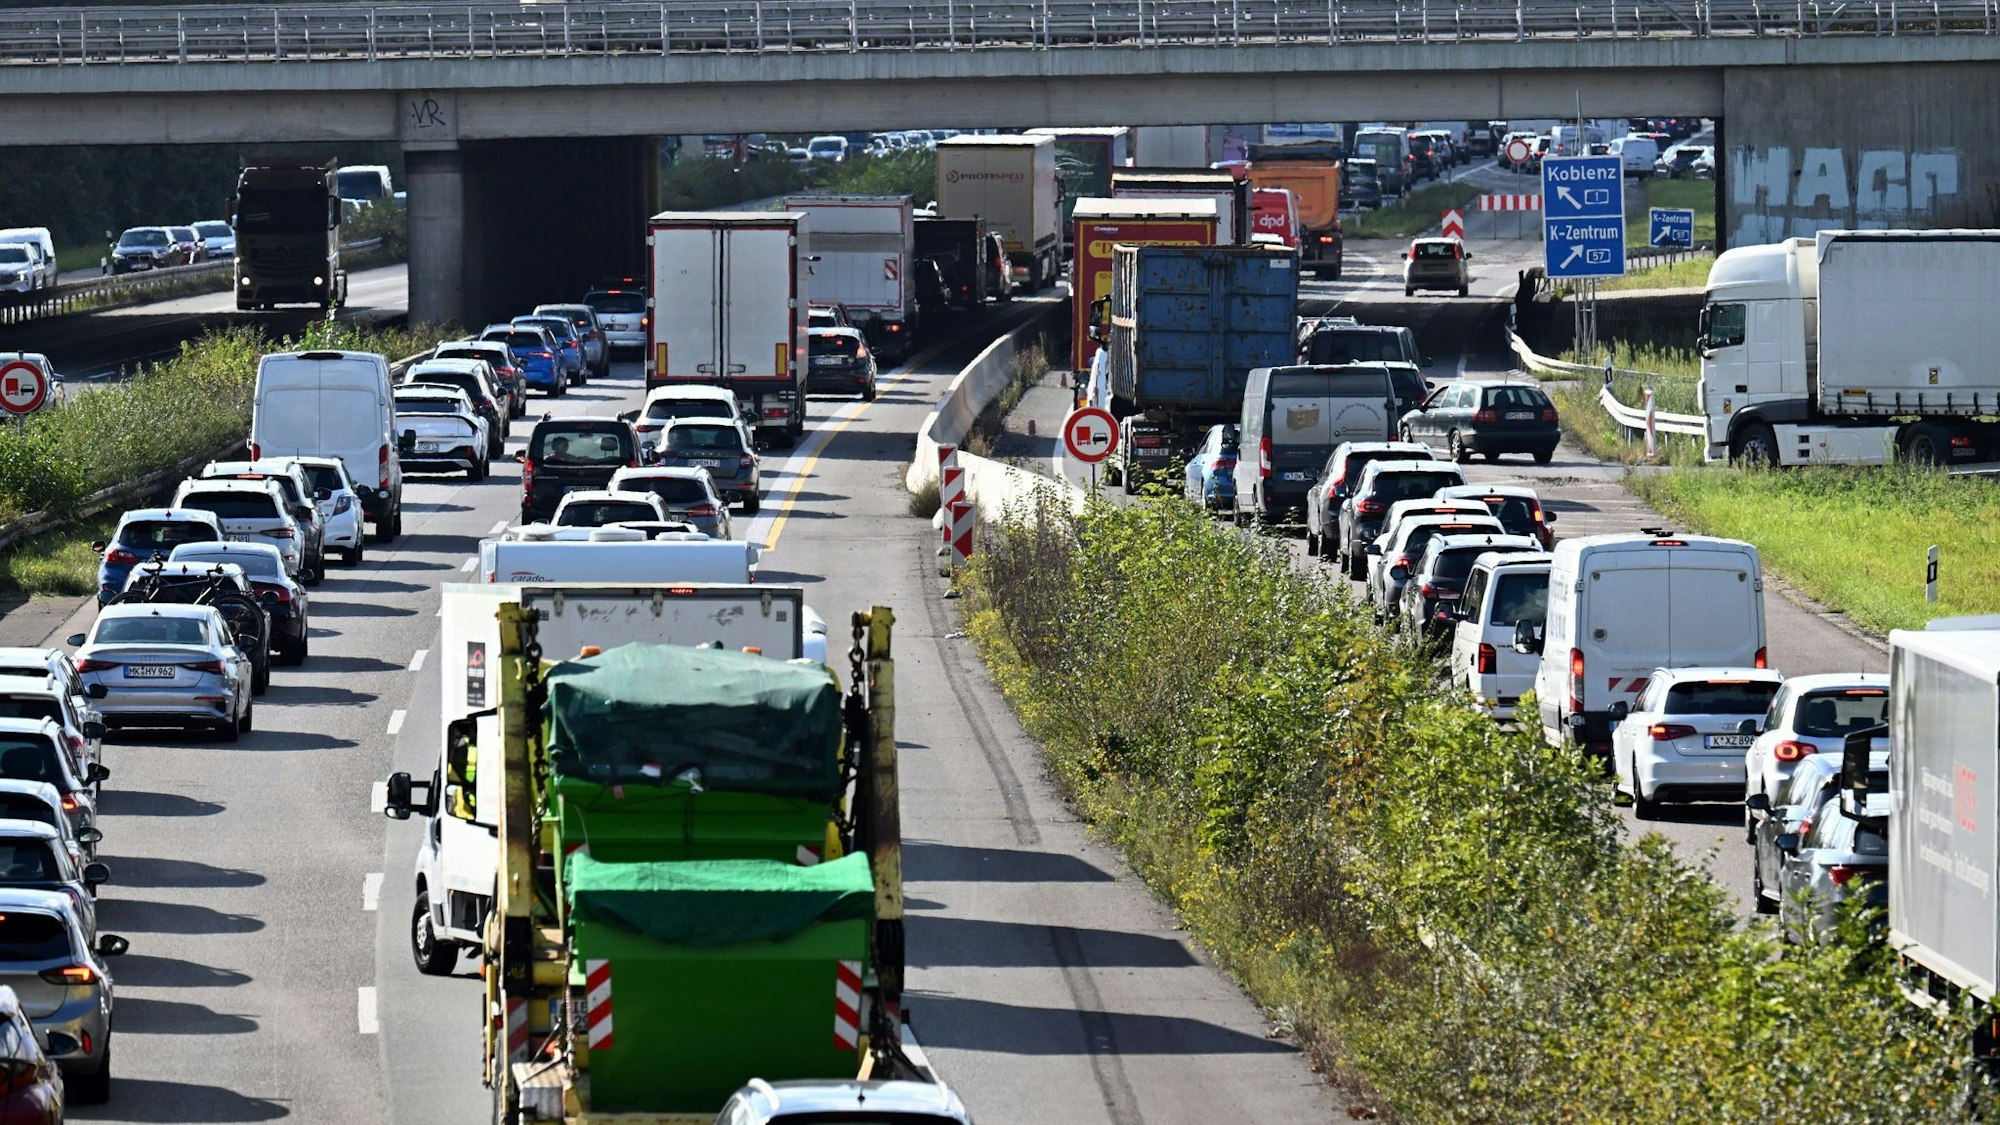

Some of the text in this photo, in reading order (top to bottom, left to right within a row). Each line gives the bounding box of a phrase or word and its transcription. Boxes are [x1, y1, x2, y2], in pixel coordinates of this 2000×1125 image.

[960, 172, 1024, 181] PROFISPED
[1548, 165, 1616, 181] Koblenz
[1594, 192, 1599, 202] 1
[1260, 214, 1285, 229] dpd
[1653, 213, 1690, 223] K-Zentrum
[1550, 225, 1618, 240] K-Zentrum
[1593, 251, 1605, 261] 57
[158, 666, 173, 676] 962
